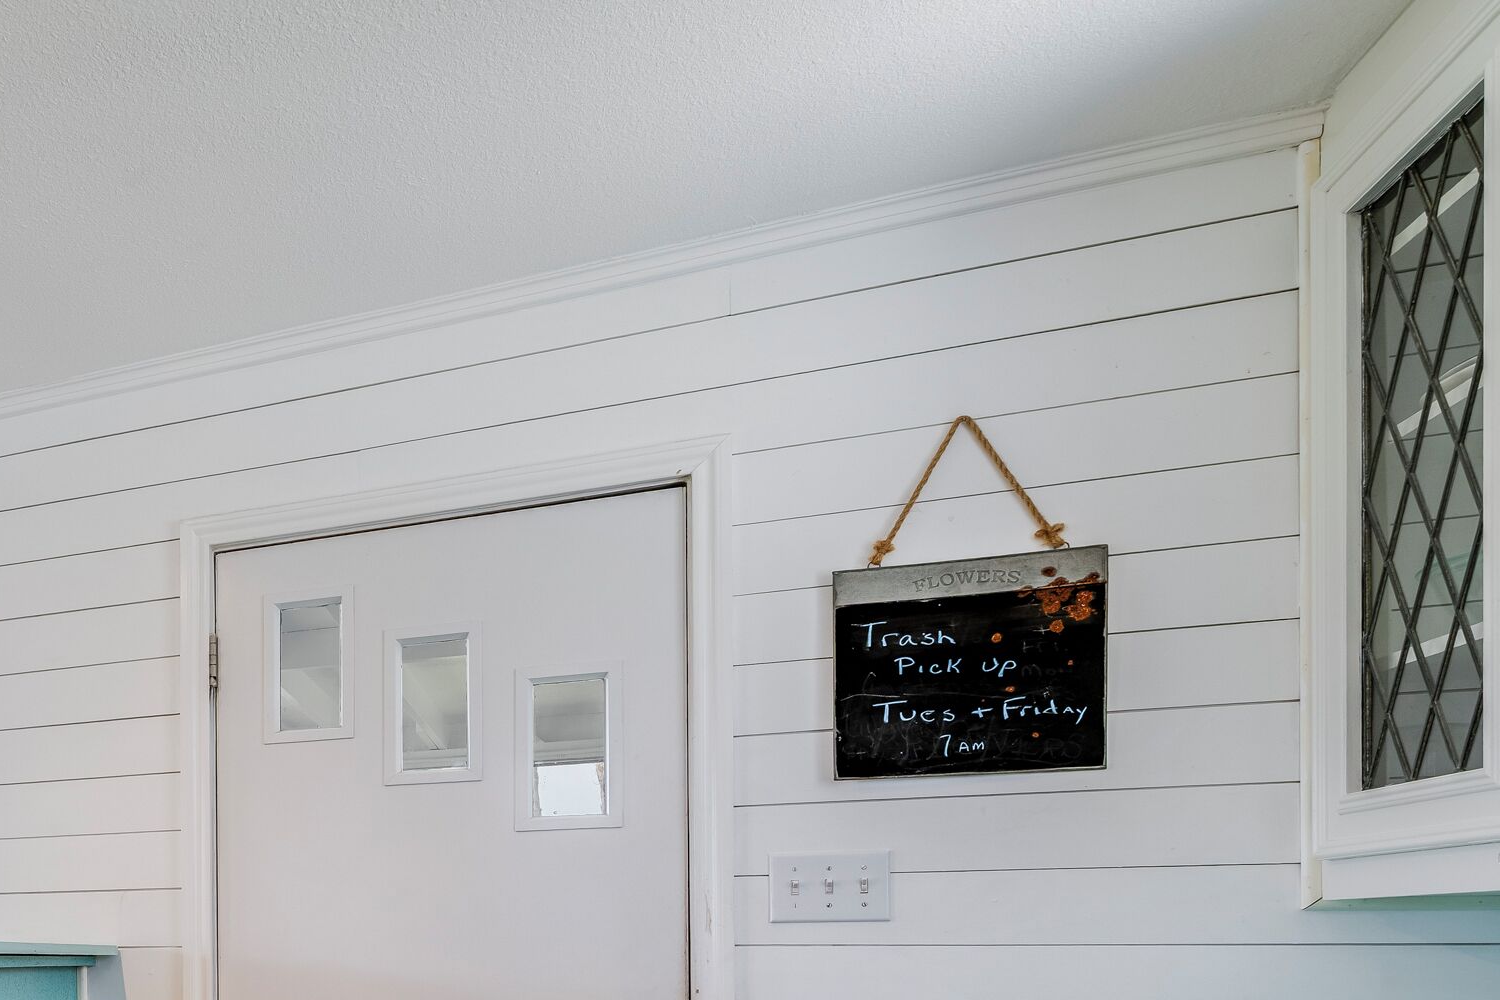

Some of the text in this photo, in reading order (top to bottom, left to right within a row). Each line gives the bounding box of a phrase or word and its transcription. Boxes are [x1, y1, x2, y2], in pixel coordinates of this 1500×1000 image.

[912, 569, 1021, 592] FLOWERS
[858, 621, 956, 648] Trash
[872, 700, 956, 724] Tues
[971, 706, 994, 718] +
[939, 734, 951, 758] 7
